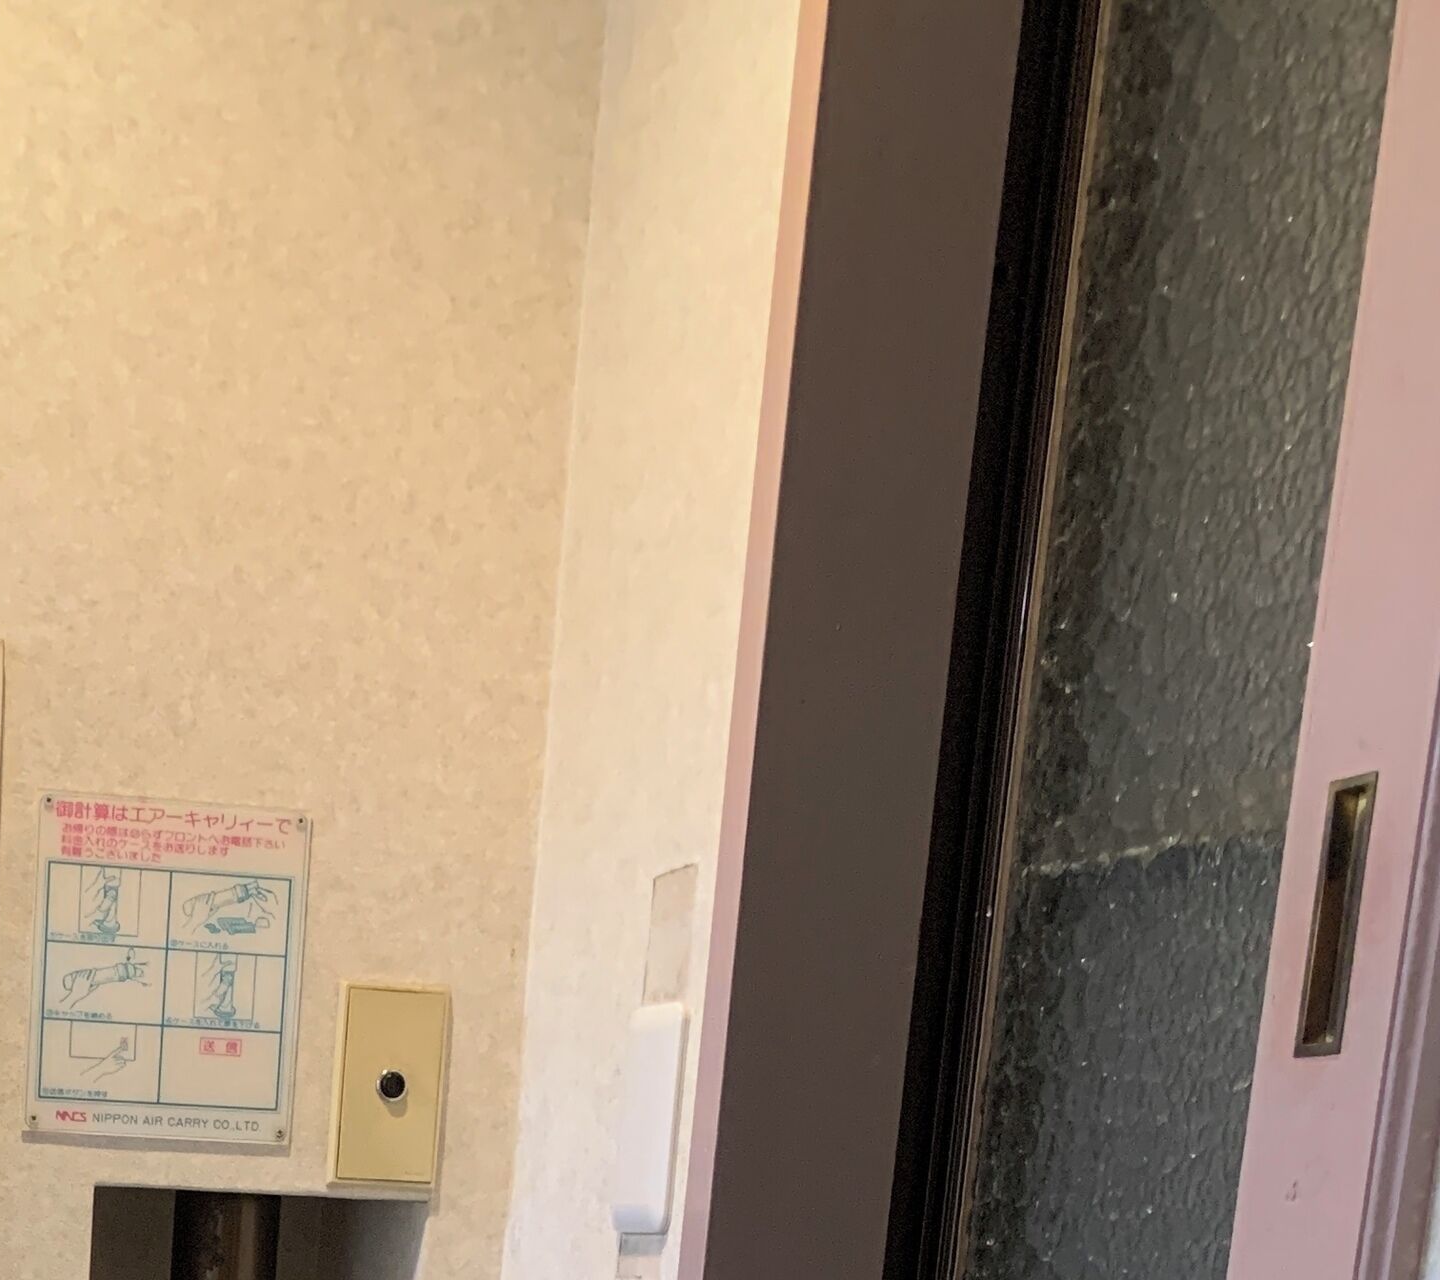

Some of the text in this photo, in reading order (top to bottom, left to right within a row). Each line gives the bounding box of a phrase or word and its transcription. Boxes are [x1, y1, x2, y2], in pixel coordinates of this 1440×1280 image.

[92, 1112, 138, 1126] NIPPON
[142, 1115, 163, 1127] AIR
[168, 1116, 208, 1129] CARRY
